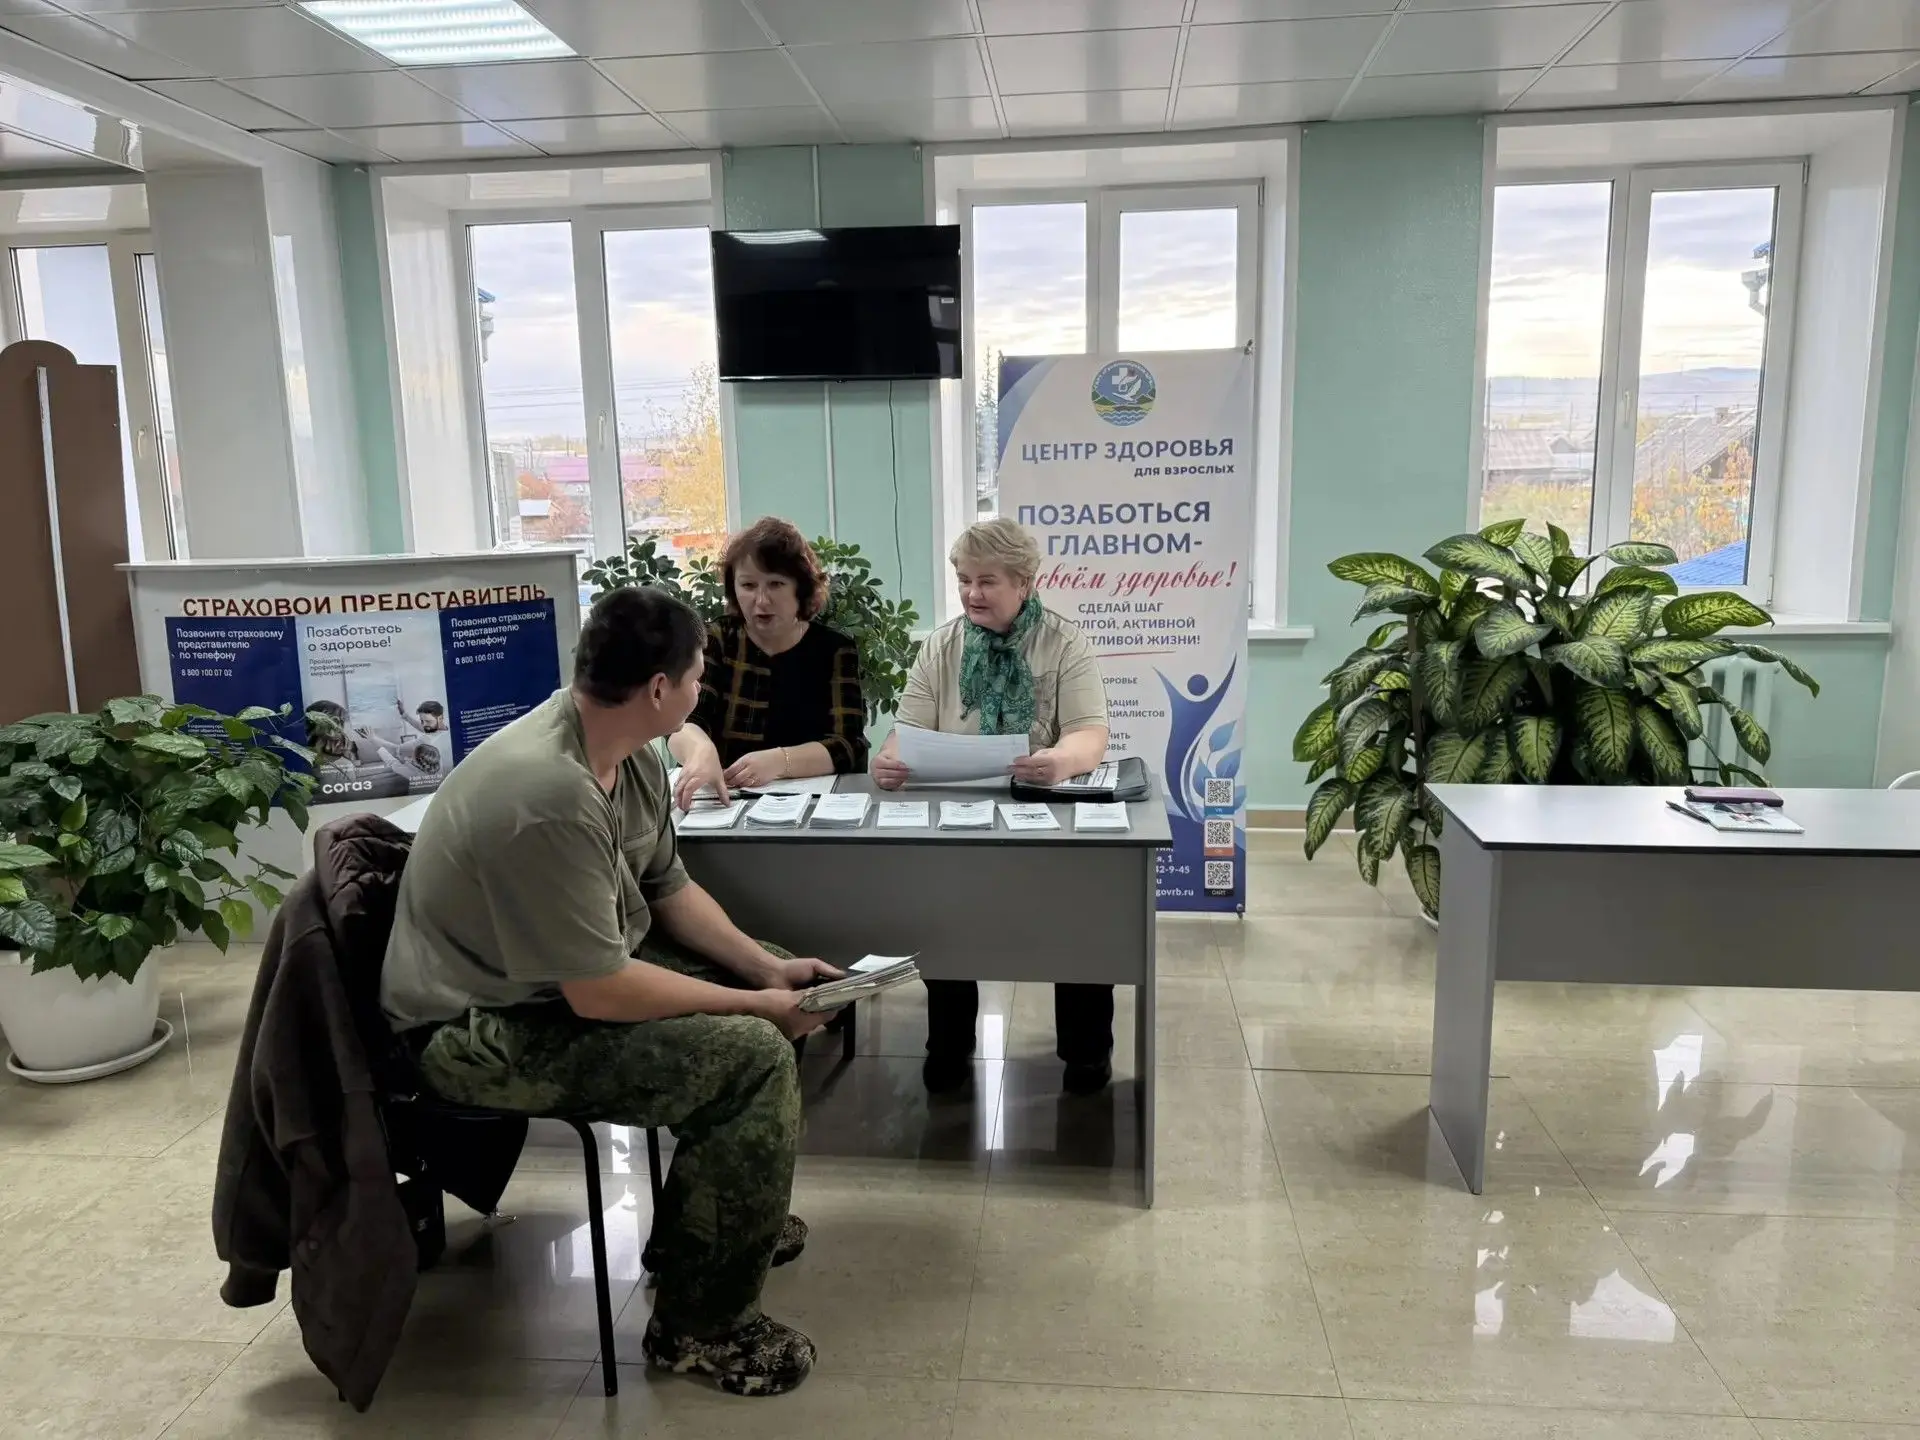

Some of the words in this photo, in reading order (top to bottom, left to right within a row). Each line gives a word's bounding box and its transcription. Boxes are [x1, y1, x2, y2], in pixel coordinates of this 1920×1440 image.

[1022, 442, 1098, 464] ЦЕНТР
[1104, 438, 1234, 462] ЗДОРОВЬЯ
[1018, 501, 1210, 526] ПОЗАБОТЬСЯ
[1047, 533, 1202, 556] ГЛАВНОМ-
[1109, 560, 1237, 597] здоровье!
[341, 584, 545, 613] ПРЕДСТАВИТЕЛЬ
[1078, 601, 1131, 614] СДЕЛАЙ
[1134, 602, 1164, 613] ШАГ
[451, 616, 497, 628] Позвоните
[498, 611, 547, 623] страховому
[1073, 618, 1120, 630] ОЛГОЙ,
[1123, 617, 1195, 629] АКТИВНОЙ
[176, 628, 226, 639] Позвоните
[227, 629, 284, 640] страховому
[306, 624, 402, 638] Позаботьтесь
[452, 624, 520, 639] представителю
[177, 641, 250, 651] представителю
[308, 643, 317, 652] о
[320, 636, 392, 653] здоровье!
[453, 641, 466, 649] по
[466, 635, 507, 647] телефону
[1087, 633, 1143, 646] ТЛИВОЙ
[1146, 634, 1200, 646] ЖИЗНИ!
[179, 651, 191, 659] по
[192, 650, 236, 662] телефону
[1102, 677, 1138, 685] ОРОВЬЕ
[1109, 710, 1165, 718] ЦИАЛИСТОВ
